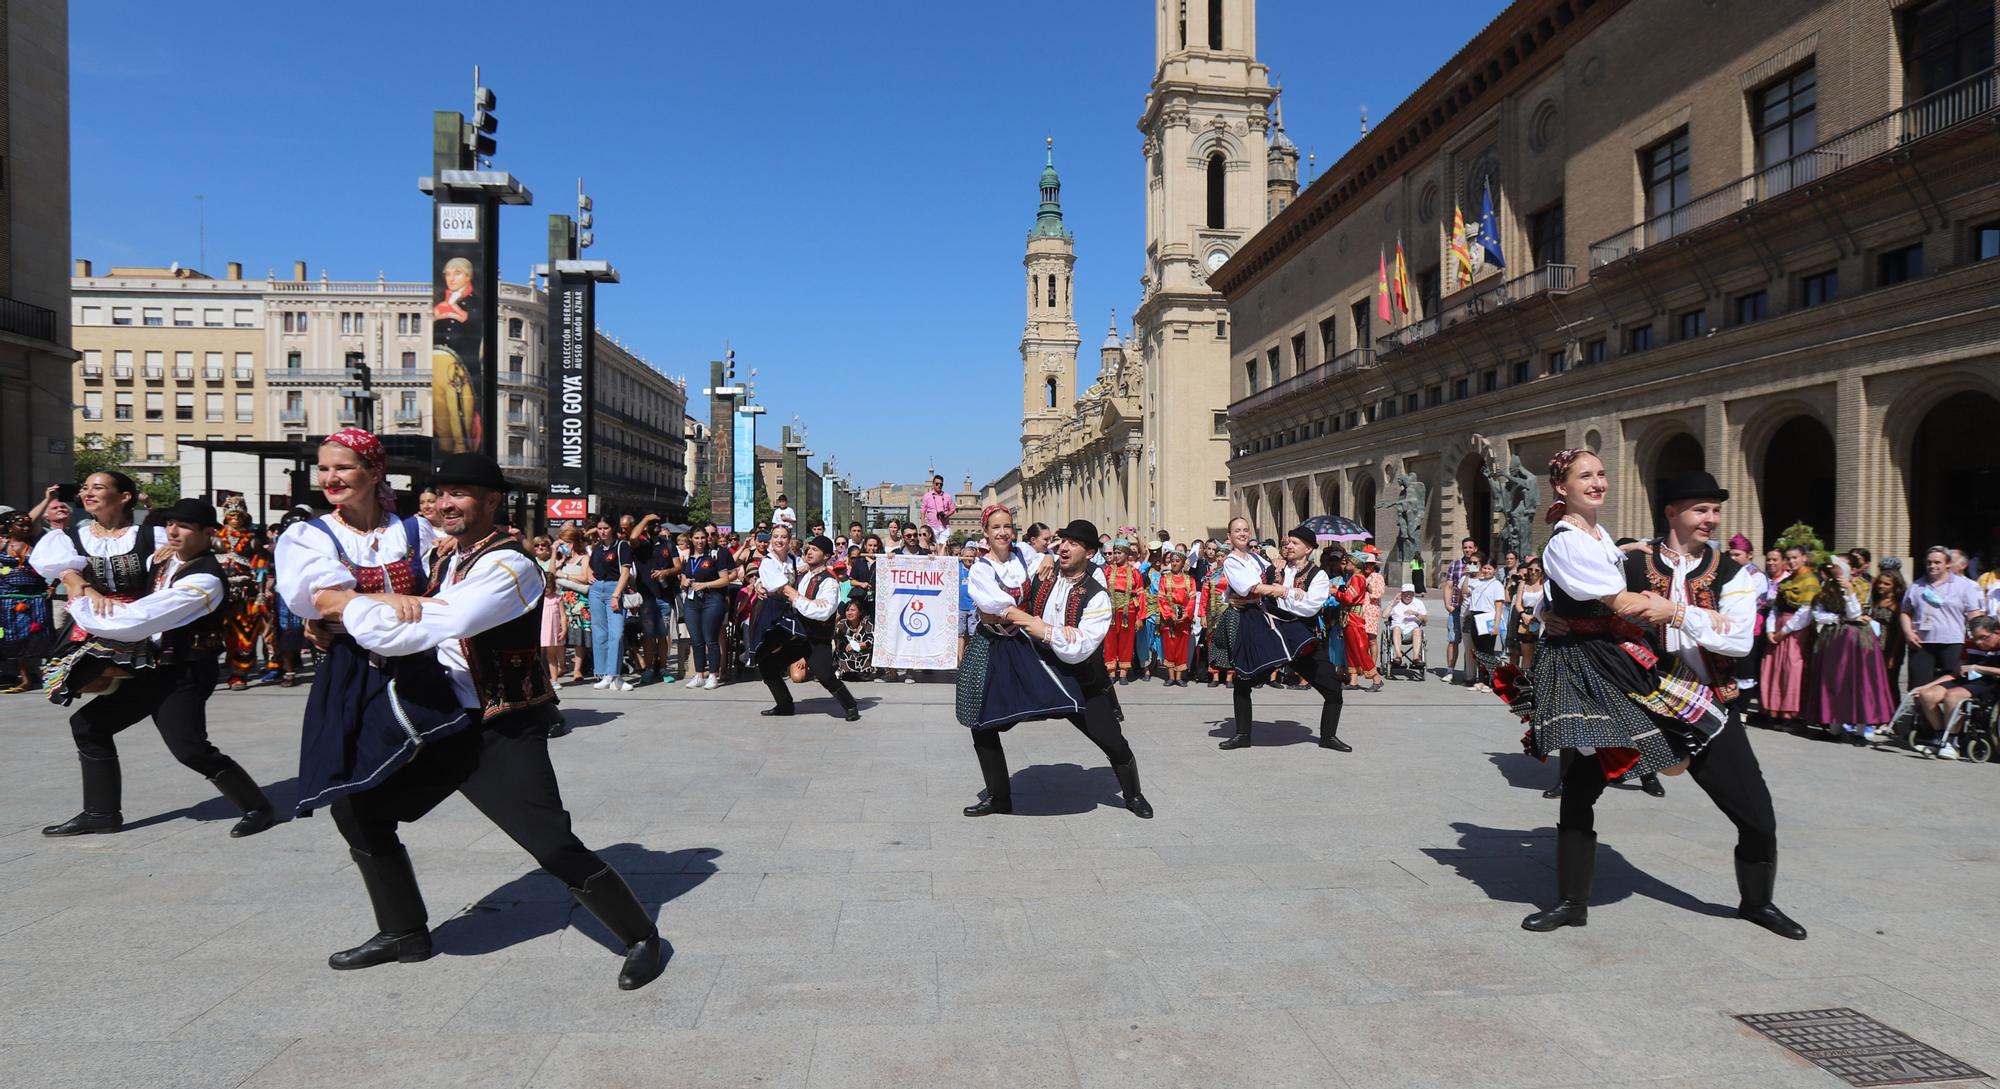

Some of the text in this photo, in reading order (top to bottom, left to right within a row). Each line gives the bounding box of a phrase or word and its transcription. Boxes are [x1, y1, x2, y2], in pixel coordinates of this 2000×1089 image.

[442, 218, 472, 230] GOYA
[562, 291, 571, 369] COLECCIÓN IBERCAJA
[573, 291, 582, 369] MUSEO CAMÓN AZNAR
[562, 418, 582, 468] MUSEO
[570, 501, 583, 509] 75
[891, 570, 944, 586] TECHNIK
